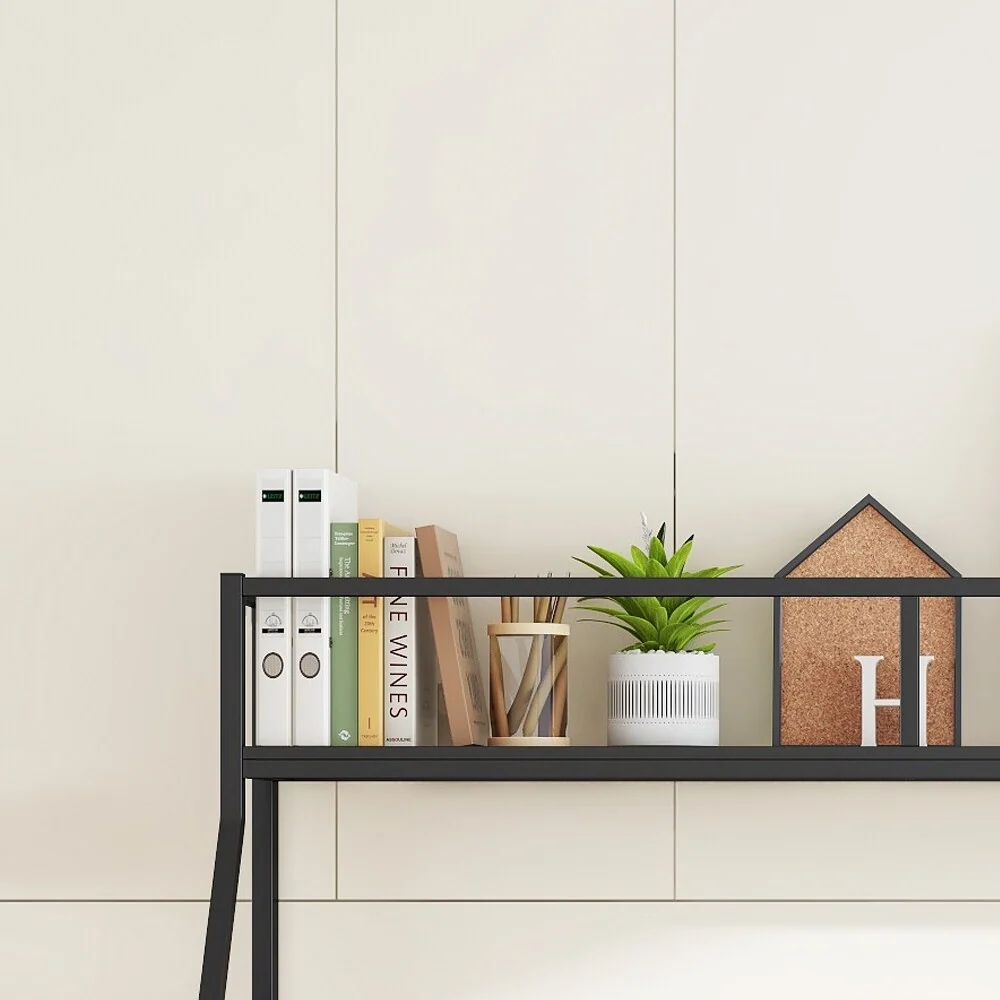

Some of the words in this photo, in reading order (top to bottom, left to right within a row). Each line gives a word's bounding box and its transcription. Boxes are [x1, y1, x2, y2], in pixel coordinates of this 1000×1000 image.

[389, 566, 408, 621] FNE
[389, 634, 408, 719] WINES
[854, 655, 935, 747] H
